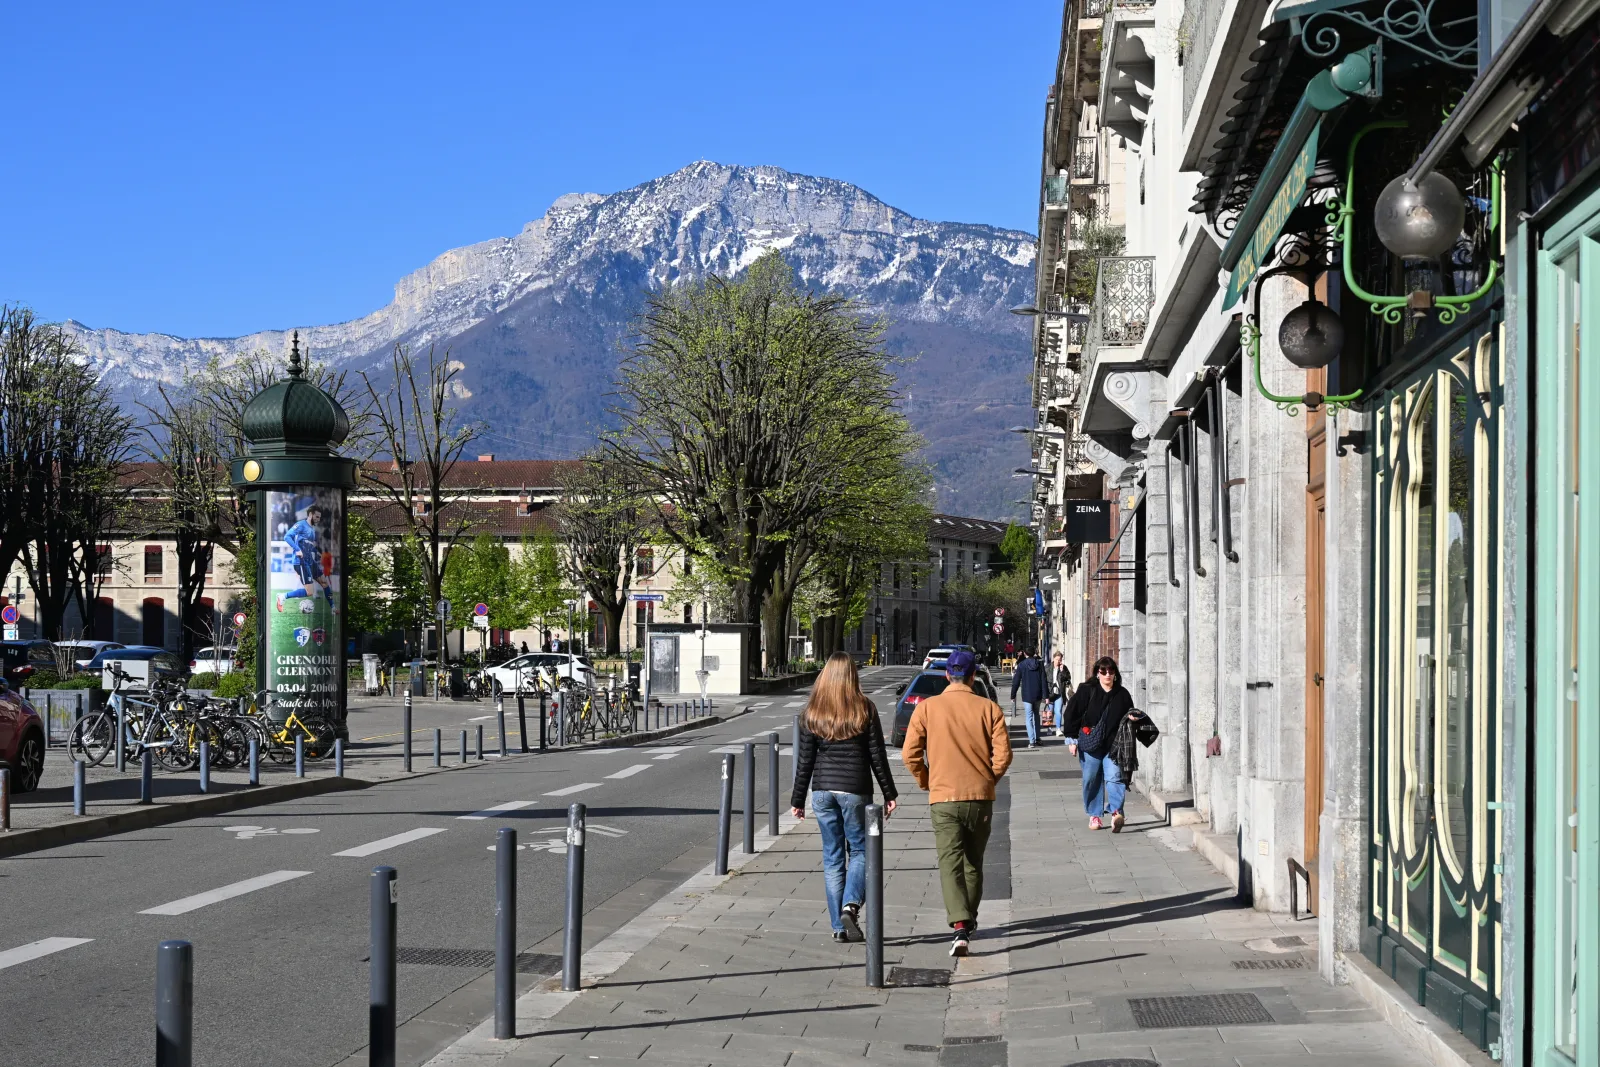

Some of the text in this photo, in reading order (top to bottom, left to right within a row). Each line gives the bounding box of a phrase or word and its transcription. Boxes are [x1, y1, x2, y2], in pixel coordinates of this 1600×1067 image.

[1076, 505, 1101, 513] ZEINA
[277, 655, 337, 665] GRENOBLE
[277, 666, 336, 676] CLERMONT
[277, 683, 338, 693] 03.04 20h00
[277, 698, 338, 709] Stade des Alpes
